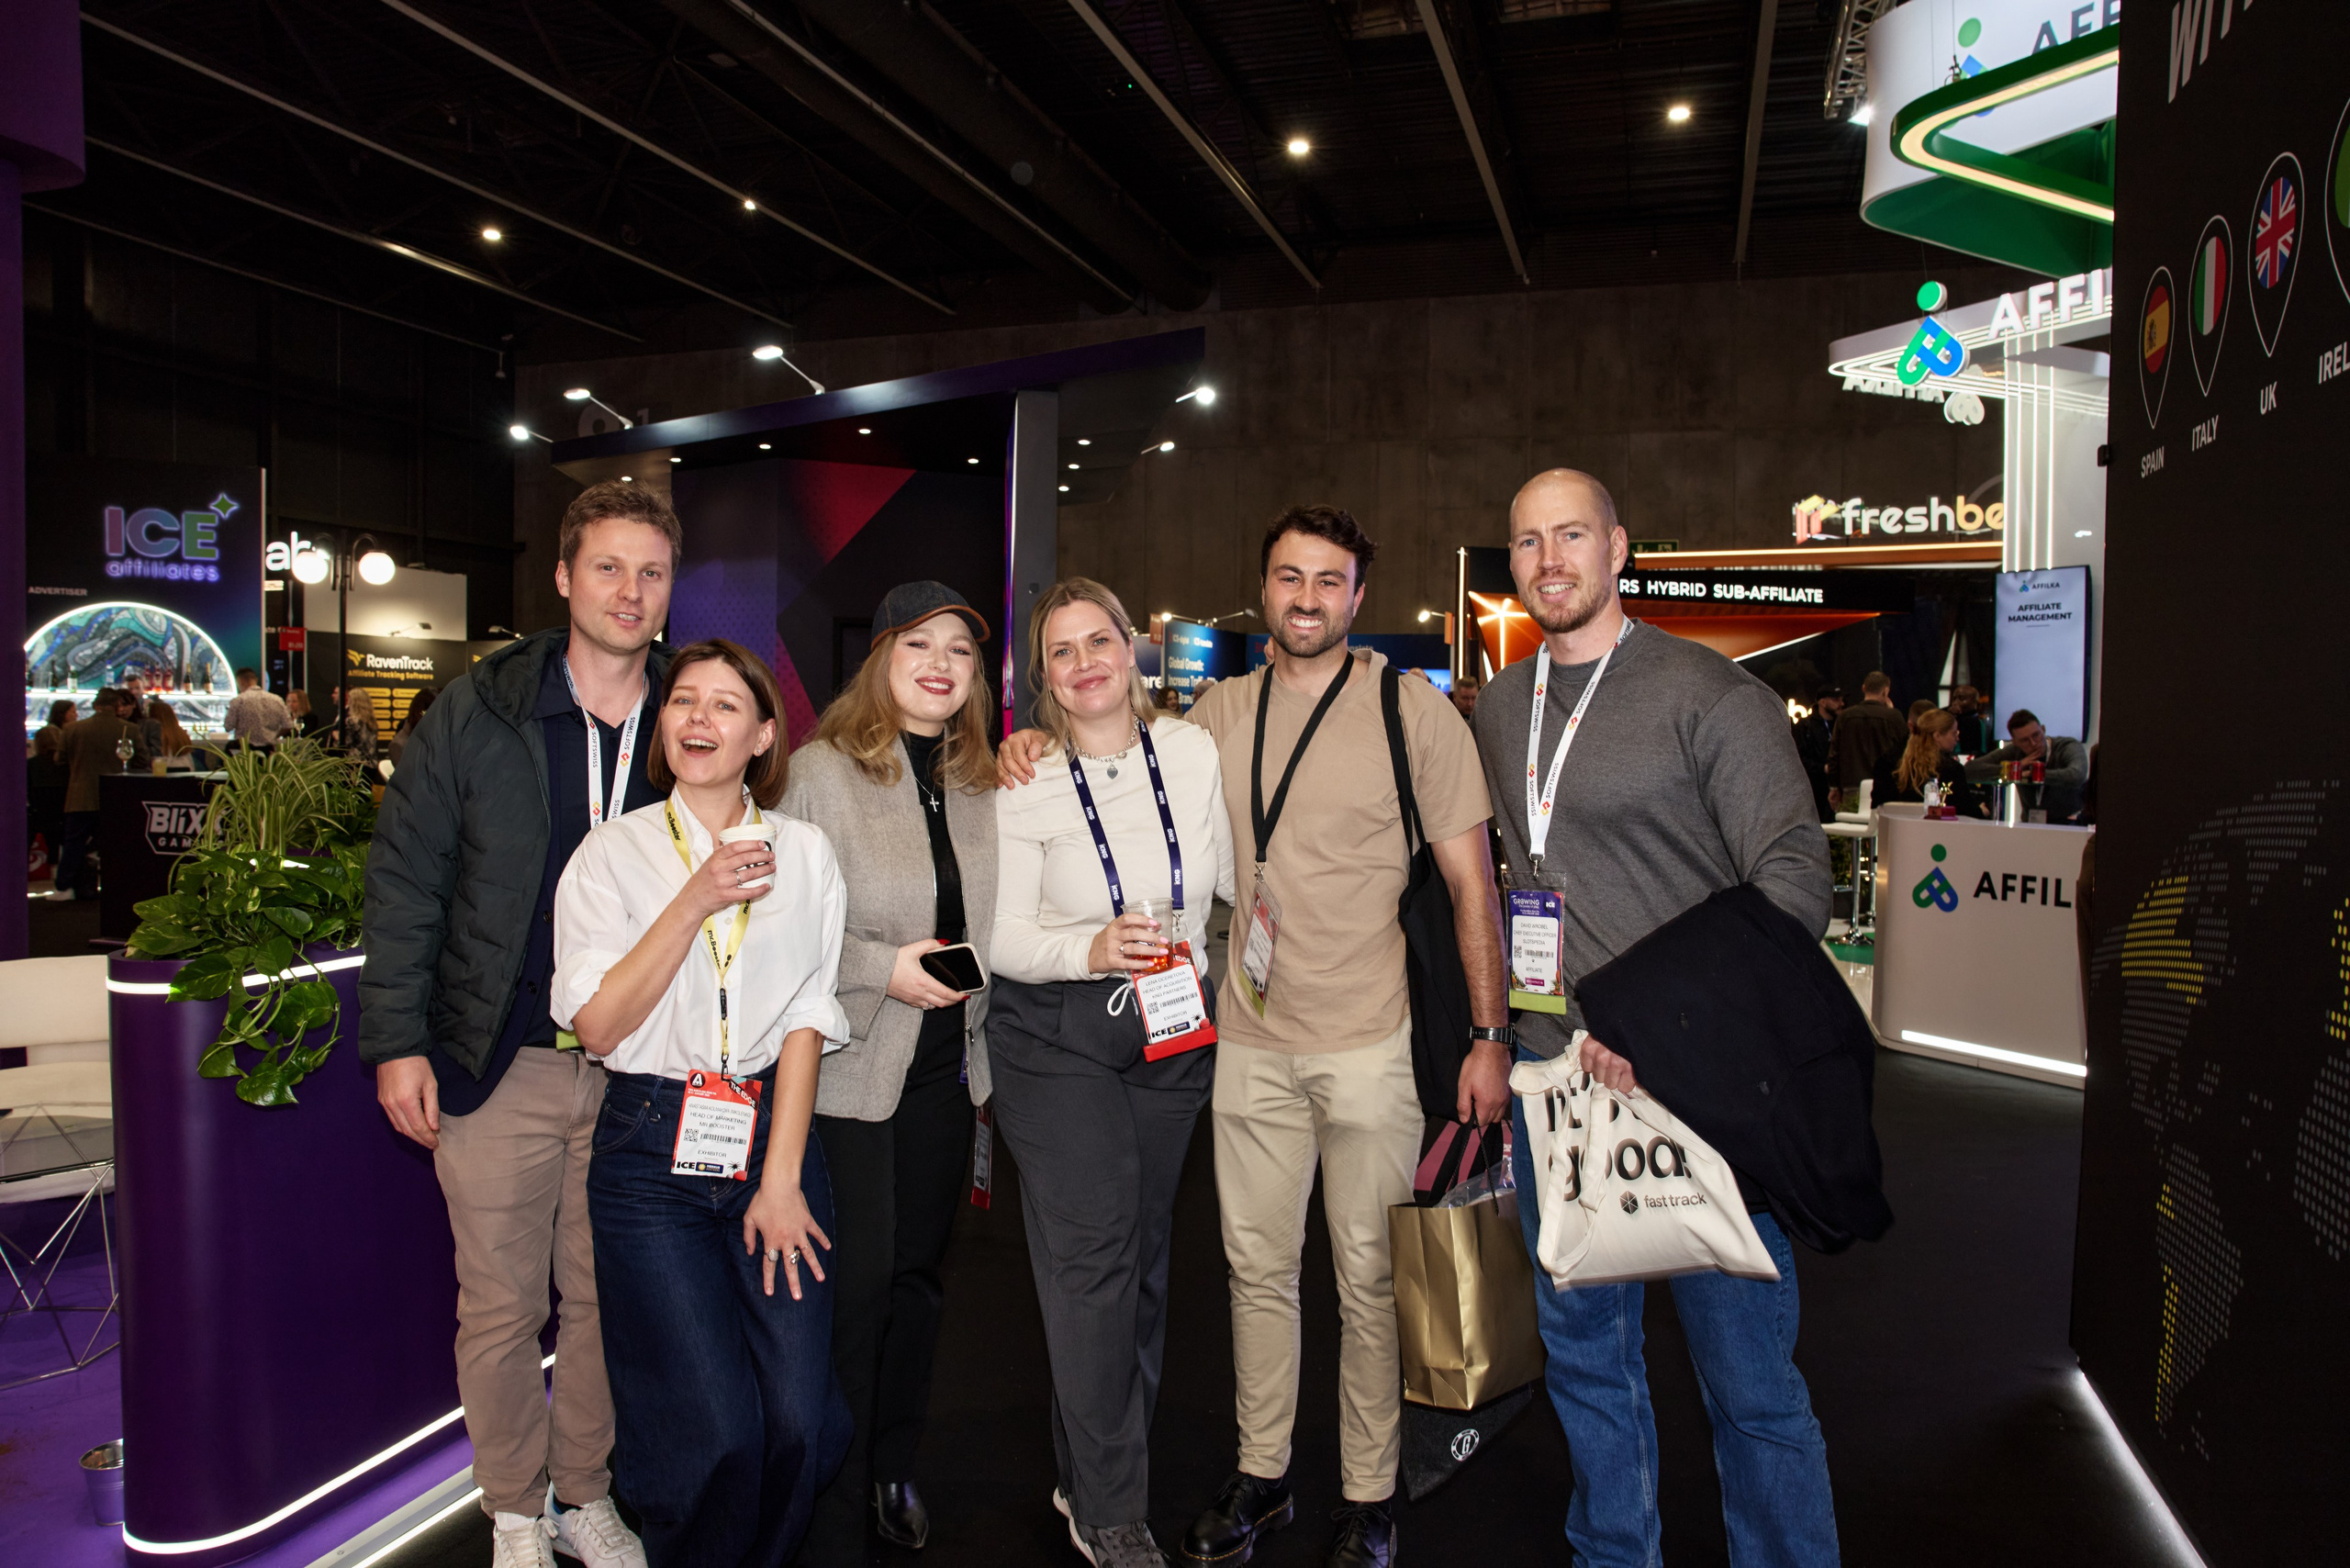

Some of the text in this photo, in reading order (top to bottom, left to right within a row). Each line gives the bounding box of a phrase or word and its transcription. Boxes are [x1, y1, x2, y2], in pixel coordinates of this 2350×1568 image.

[2260, 381, 2277, 415] UK
[2192, 414, 2219, 452] ITALY
[2141, 446, 2165, 478] SPAIN
[105, 506, 218, 560] ICE
[106, 559, 220, 581] affiliates
[28, 587, 88, 597] ADVERTISER
[1648, 580, 1707, 597] HYBRID
[1713, 584, 1824, 603] SUB-AFFILIATE
[2008, 612, 2072, 622] MANAGEMENT
[2018, 602, 2062, 612] AFFILIATE
[366, 654, 433, 670] RavenTrack
[375, 670, 406, 680] Tracking
[1576, 681, 1595, 714] SOFTSWISS
[1533, 699, 1541, 732] SOFTSWISS
[624, 716, 636, 750] SOFTSWISS
[1546, 762, 1559, 799] SOFTSWISS
[666, 811, 681, 842] mr.Booster
[1973, 871, 2072, 908] AFFIL
[707, 929, 722, 970] mr.Booster
[1151, 1028, 1167, 1037] ICE
[731, 1082, 742, 1095] THE
[741, 1092, 756, 1108] EDGE
[715, 1115, 746, 1125] MARKETING
[698, 1149, 726, 1158] EXHIBITOR
[1644, 1193, 1707, 1208] fast track
